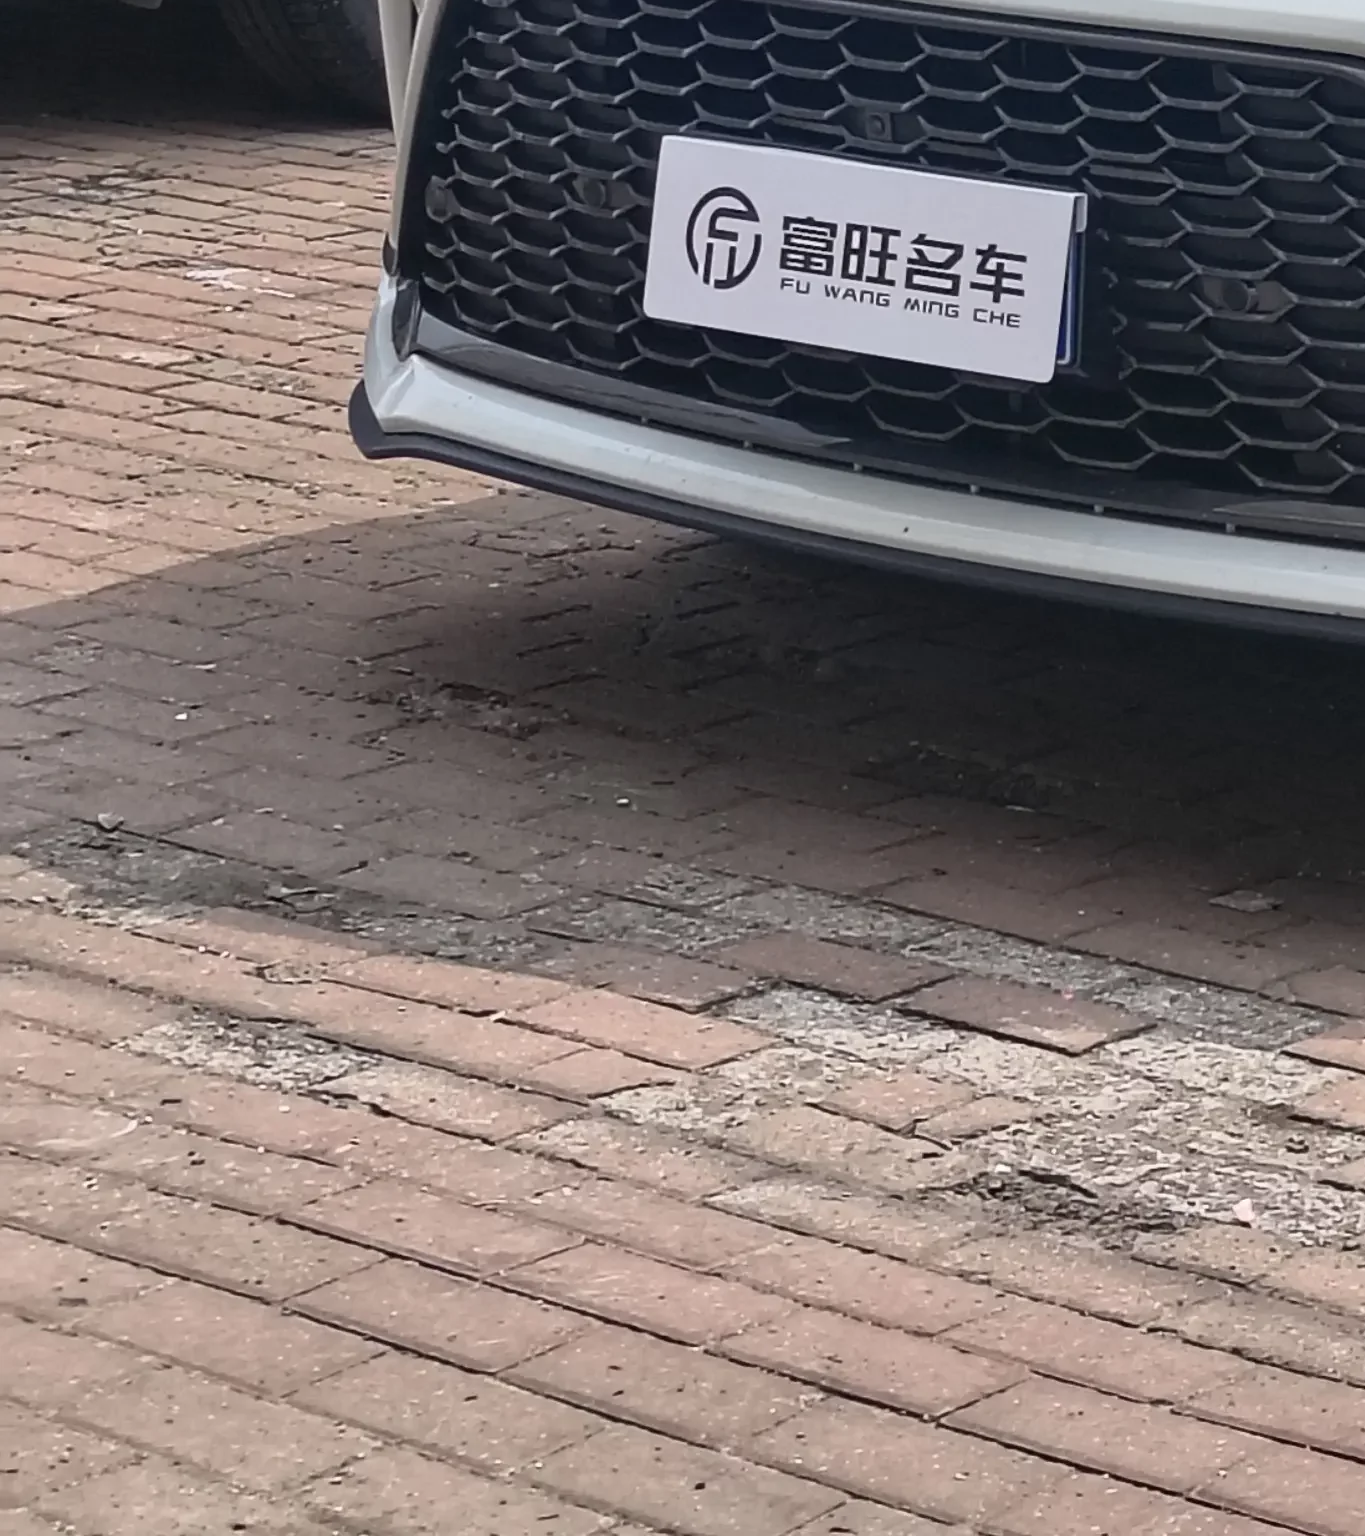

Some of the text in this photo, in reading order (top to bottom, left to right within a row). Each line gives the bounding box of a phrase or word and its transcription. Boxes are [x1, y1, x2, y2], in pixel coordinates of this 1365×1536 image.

[779, 216, 1027, 303] 富旺名车
[780, 278, 1021, 328] FU WANG MING CHE
